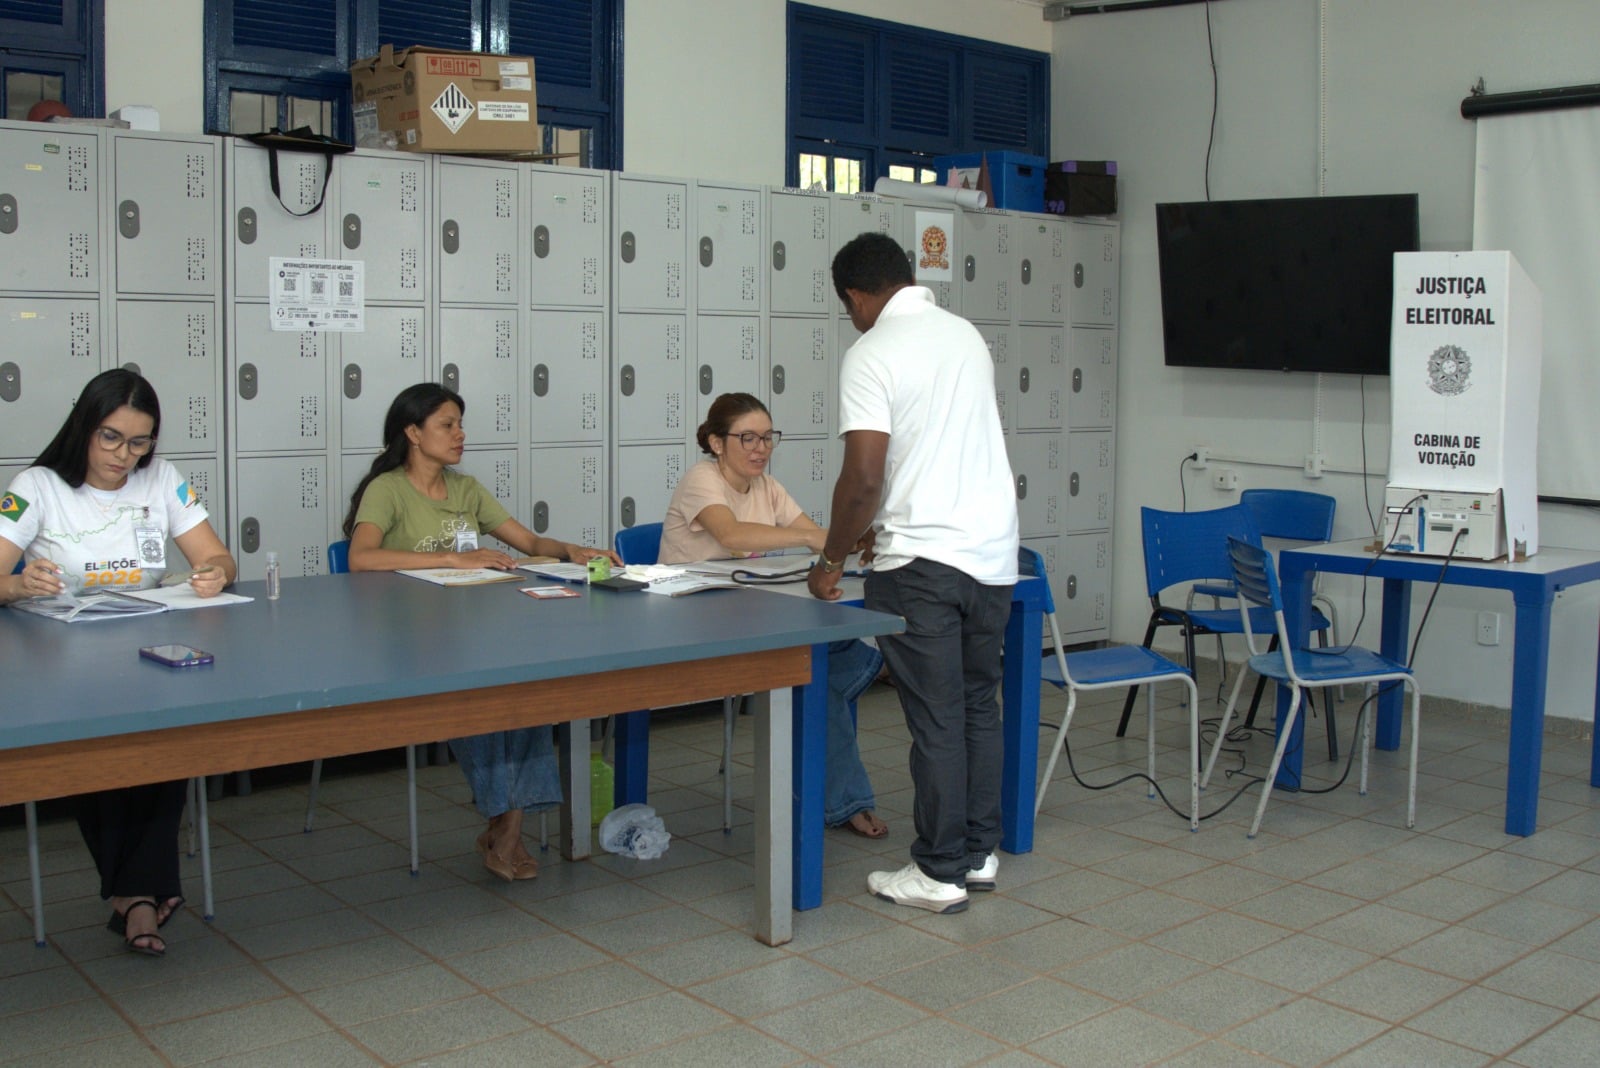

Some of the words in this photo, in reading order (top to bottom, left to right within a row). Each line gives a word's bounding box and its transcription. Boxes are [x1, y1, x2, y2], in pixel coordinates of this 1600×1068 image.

[1416, 277, 1486, 299] JUSTIÇA
[1406, 308, 1495, 325] ELEITORAL
[1414, 433, 1460, 448] CABINA
[1464, 436, 1480, 449] DE
[1418, 450, 1475, 469] VOTAÇÃO
[85, 557, 138, 571] ELEIÇÕE
[84, 568, 143, 588] 2026
